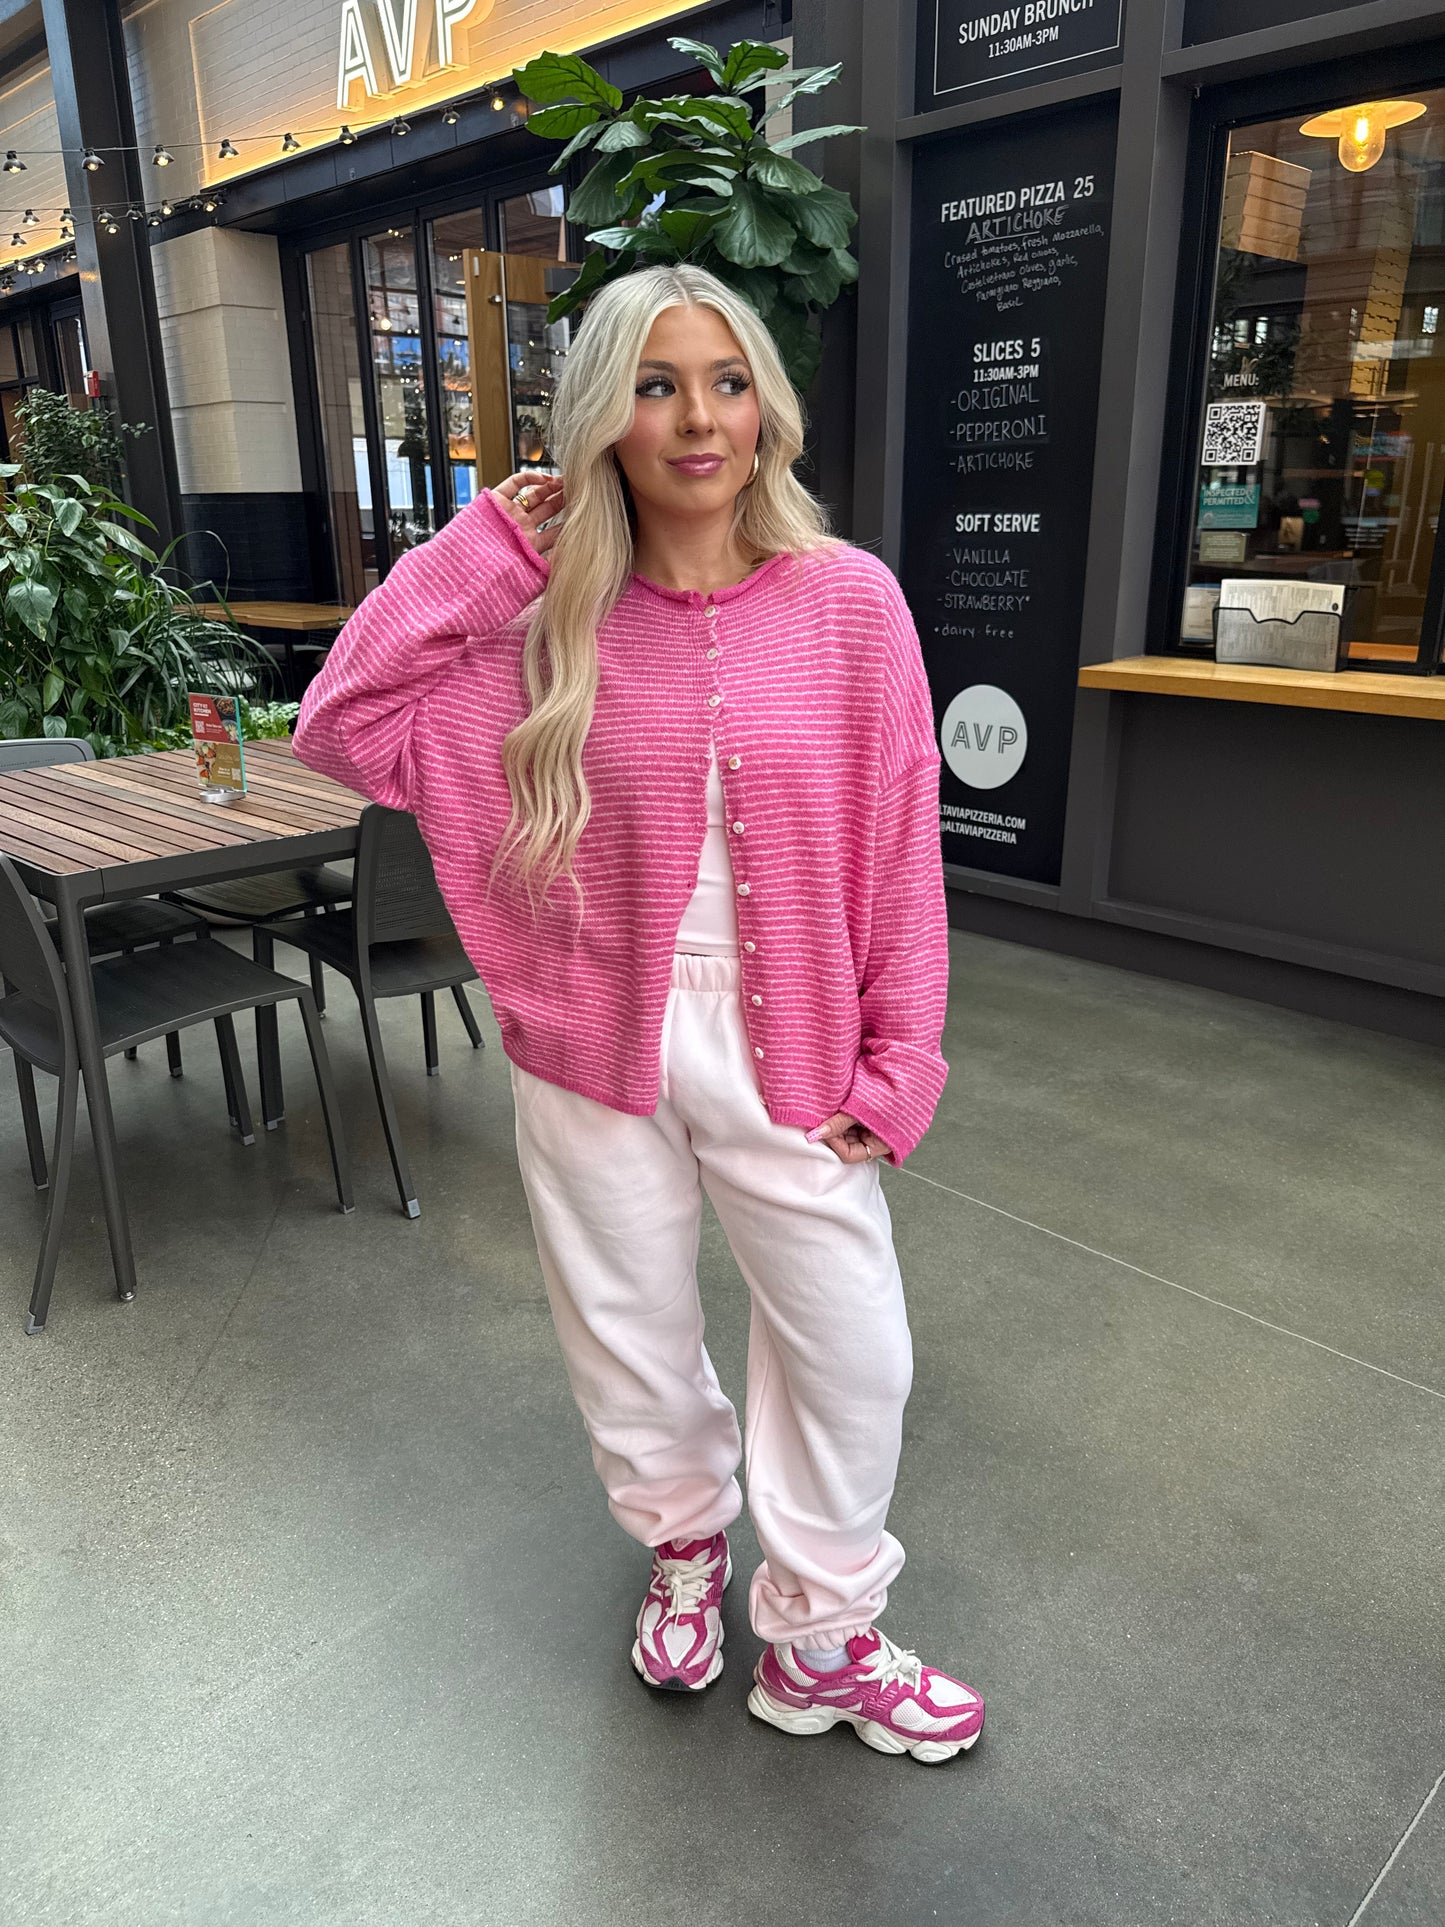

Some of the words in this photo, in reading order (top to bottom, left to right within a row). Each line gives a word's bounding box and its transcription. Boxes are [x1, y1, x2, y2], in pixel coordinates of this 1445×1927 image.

[958, 7, 1021, 44] SUNDAY
[988, 25, 1059, 58] 11:30AM-3PM
[337, 0, 478, 110] AVP
[941, 191, 1016, 223] FEATURED
[1019, 181, 1065, 208] PIZZA
[1073, 175, 1094, 199] 25
[965, 204, 1069, 245] ARTICHOKE
[973, 339, 1024, 363] SLICES
[1030, 337, 1040, 358] 5
[973, 364, 1039, 383] 11:30AM-3PM
[1223, 373, 1259, 387] MENU:
[1202, 497, 1245, 506] PERMITTED
[1203, 488, 1246, 497] INSPECTED
[955, 514, 991, 532] SOFT
[993, 514, 1040, 532] SERVE
[985, 624, 1014, 638] free
[951, 721, 1018, 754] AVP
